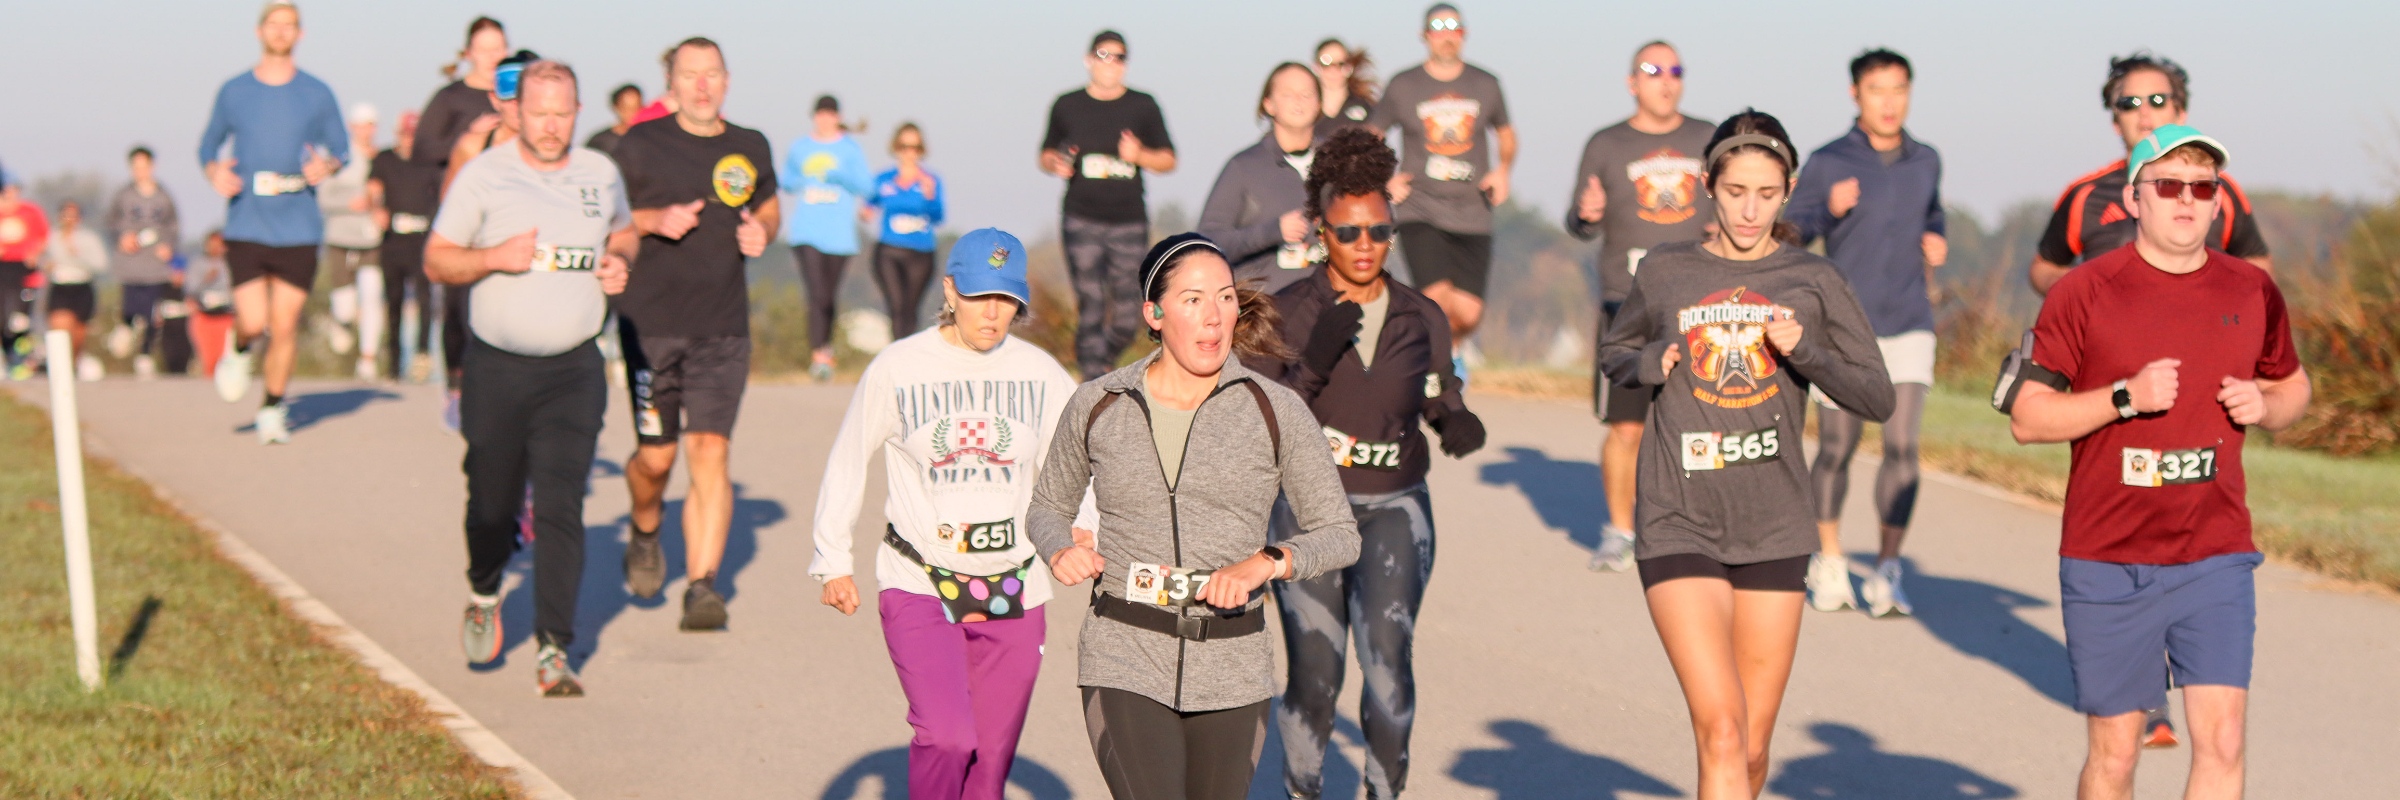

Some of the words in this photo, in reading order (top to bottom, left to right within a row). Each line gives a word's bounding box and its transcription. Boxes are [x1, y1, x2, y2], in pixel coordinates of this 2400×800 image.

[556, 248, 594, 269] 377
[1678, 300, 1794, 334] ROCKTÖBERFT
[895, 379, 975, 443] RALSTON
[1352, 442, 1400, 467] 372
[1722, 429, 1779, 462] 565
[919, 461, 1023, 487] OMPAN
[2162, 450, 2215, 480] 327
[970, 523, 1013, 549] 651
[1168, 573, 1211, 600] 37
